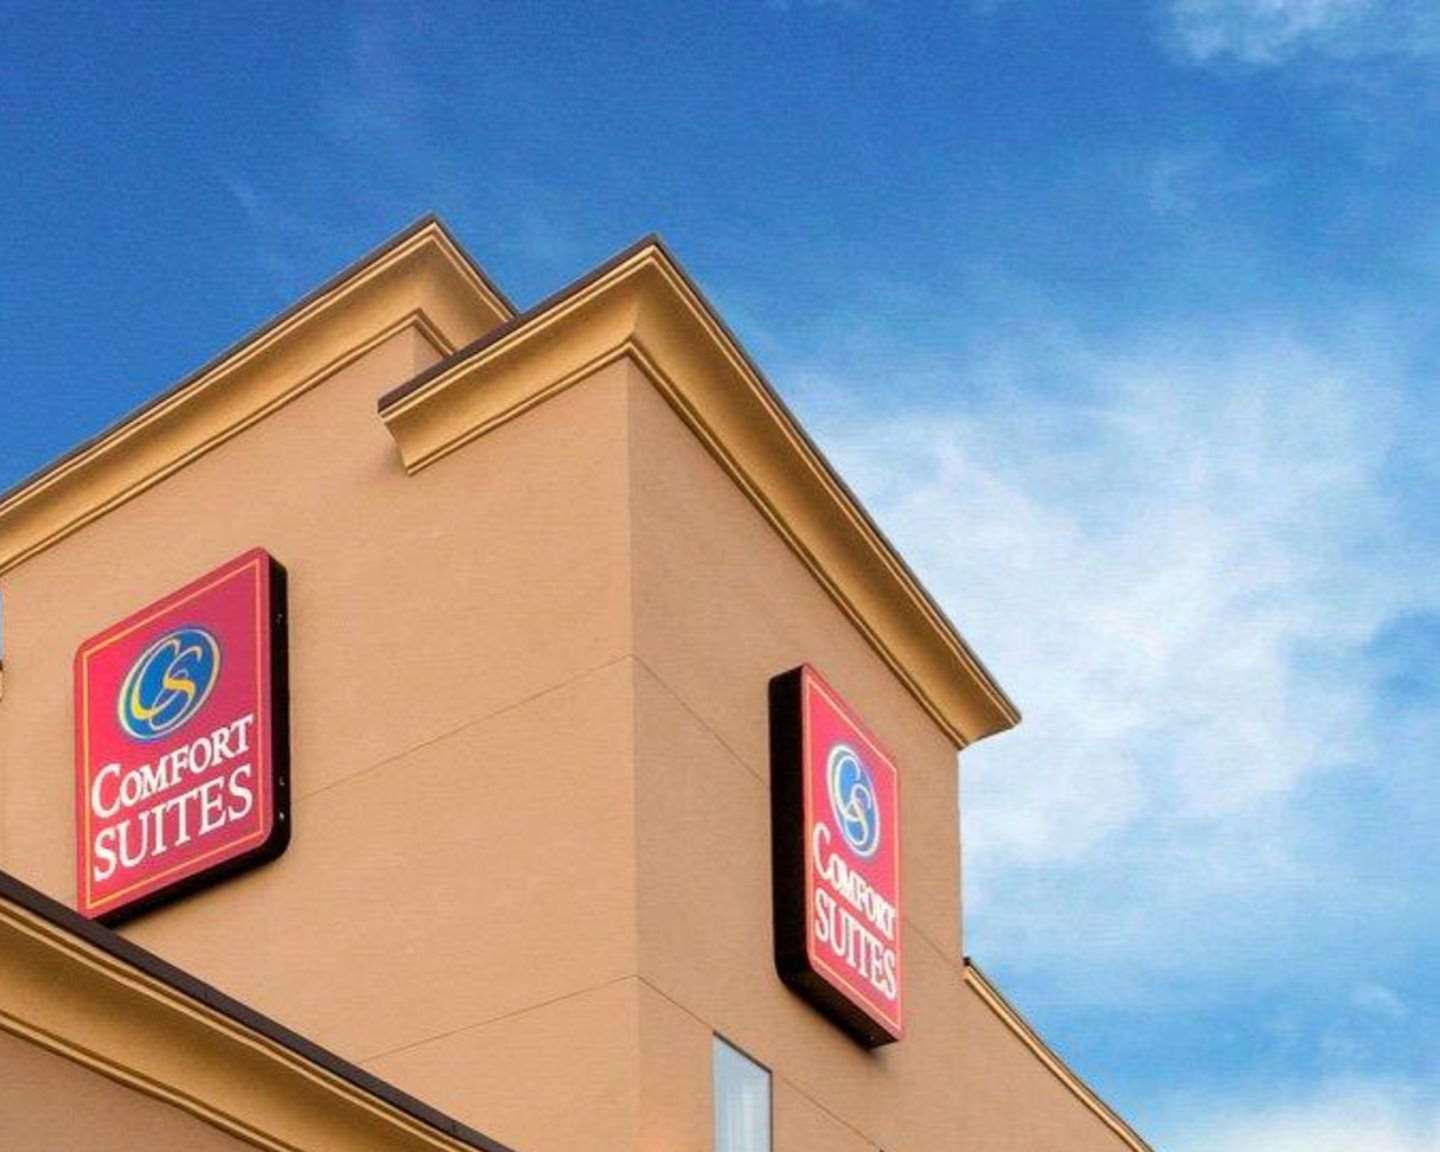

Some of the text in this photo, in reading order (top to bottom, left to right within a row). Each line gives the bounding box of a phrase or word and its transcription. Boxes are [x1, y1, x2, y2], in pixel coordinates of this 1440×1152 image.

[91, 715, 254, 818] COMFORT
[94, 764, 253, 881] SUITES
[813, 823, 896, 941] COMFORT
[814, 888, 897, 1001] SUITES
